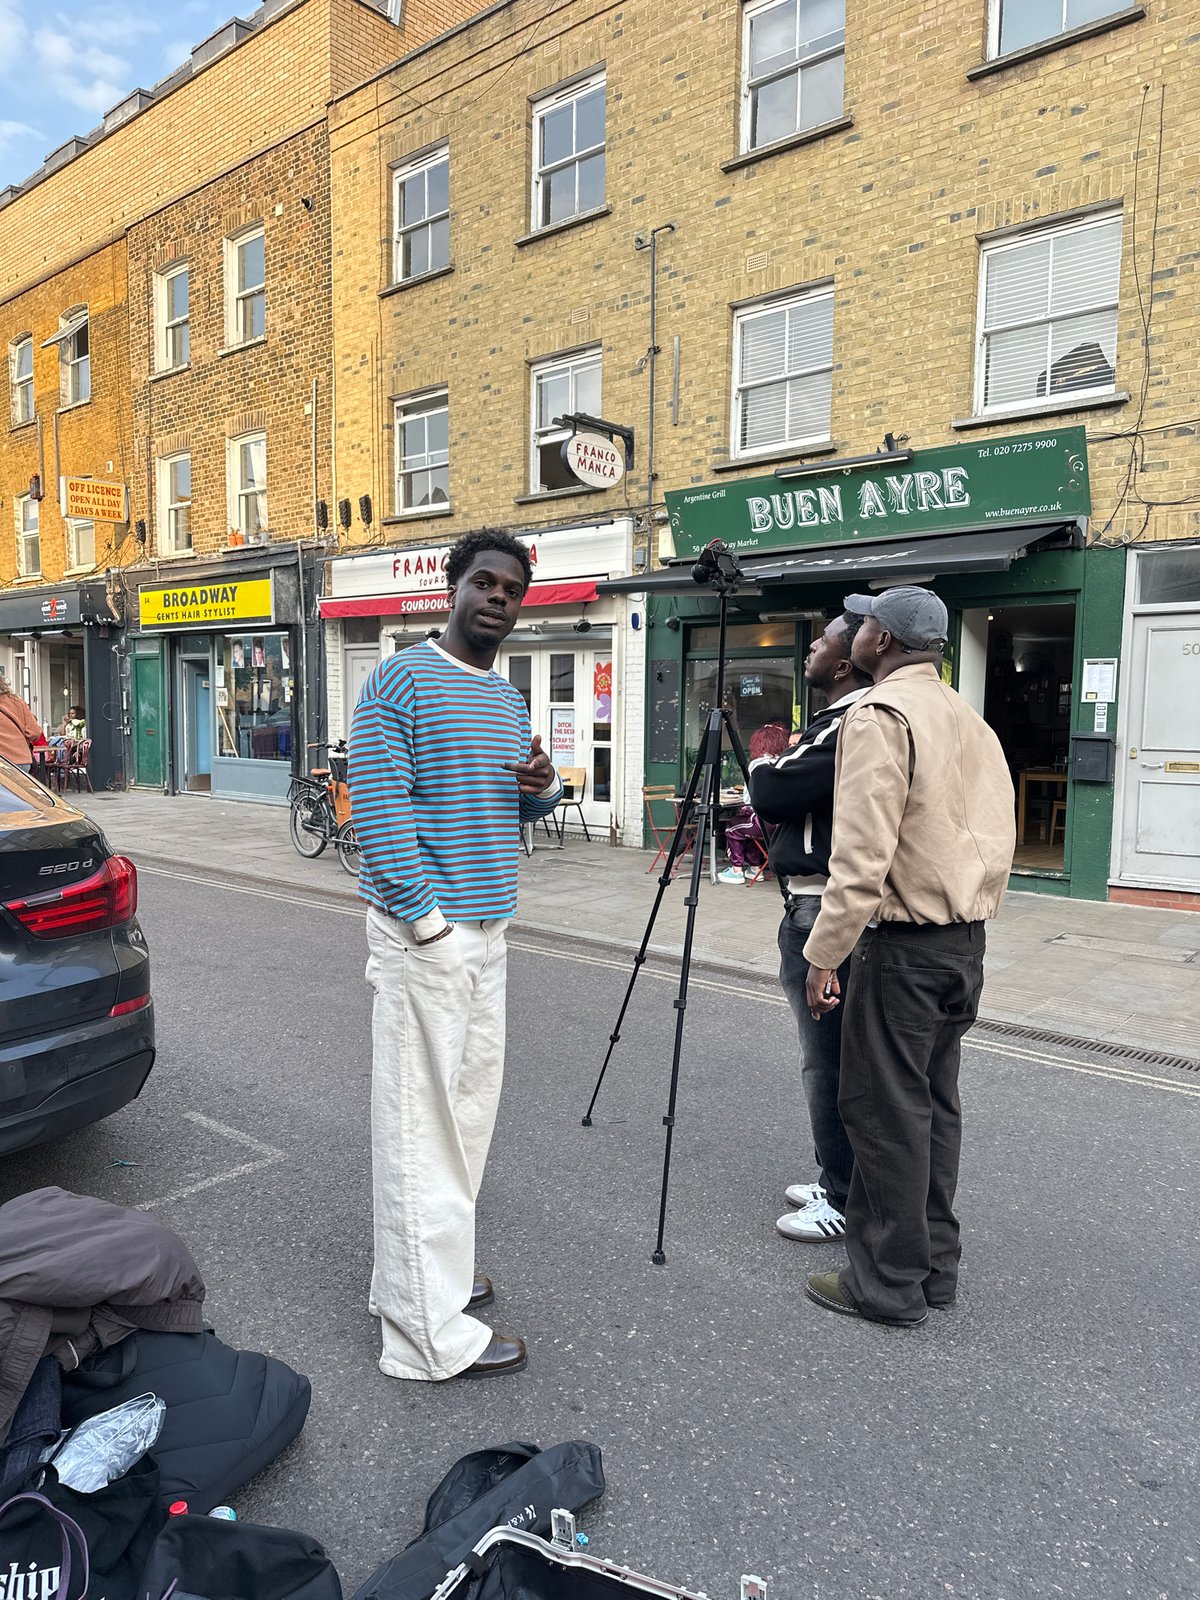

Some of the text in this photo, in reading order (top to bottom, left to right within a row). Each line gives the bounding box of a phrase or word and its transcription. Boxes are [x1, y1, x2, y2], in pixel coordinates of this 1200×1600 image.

[576, 443, 616, 463] FRANCO
[978, 438, 1057, 458] Tel. 020 7275 9900
[577, 456, 616, 478] MANCA
[69, 482, 122, 497] OFF LICENCE
[683, 489, 726, 504] Argentine Grill
[70, 495, 121, 508] OPEN ALL DAY
[746, 466, 971, 533] BUEN AYRE
[69, 505, 74, 513] 7
[74, 506, 94, 516] DAYS
[100, 509, 123, 519] WEEK
[692, 545, 700, 553] 50
[737, 538, 759, 548] Market
[393, 554, 447, 579] FRANC
[419, 575, 446, 587] SOURD
[163, 586, 238, 608] BROADWAY
[401, 598, 450, 612] SOURDOUG
[156, 607, 236, 621] GENTS HAIR STYLIST
[1182, 643, 1200, 656] 50
[742, 686, 761, 695] OPEN
